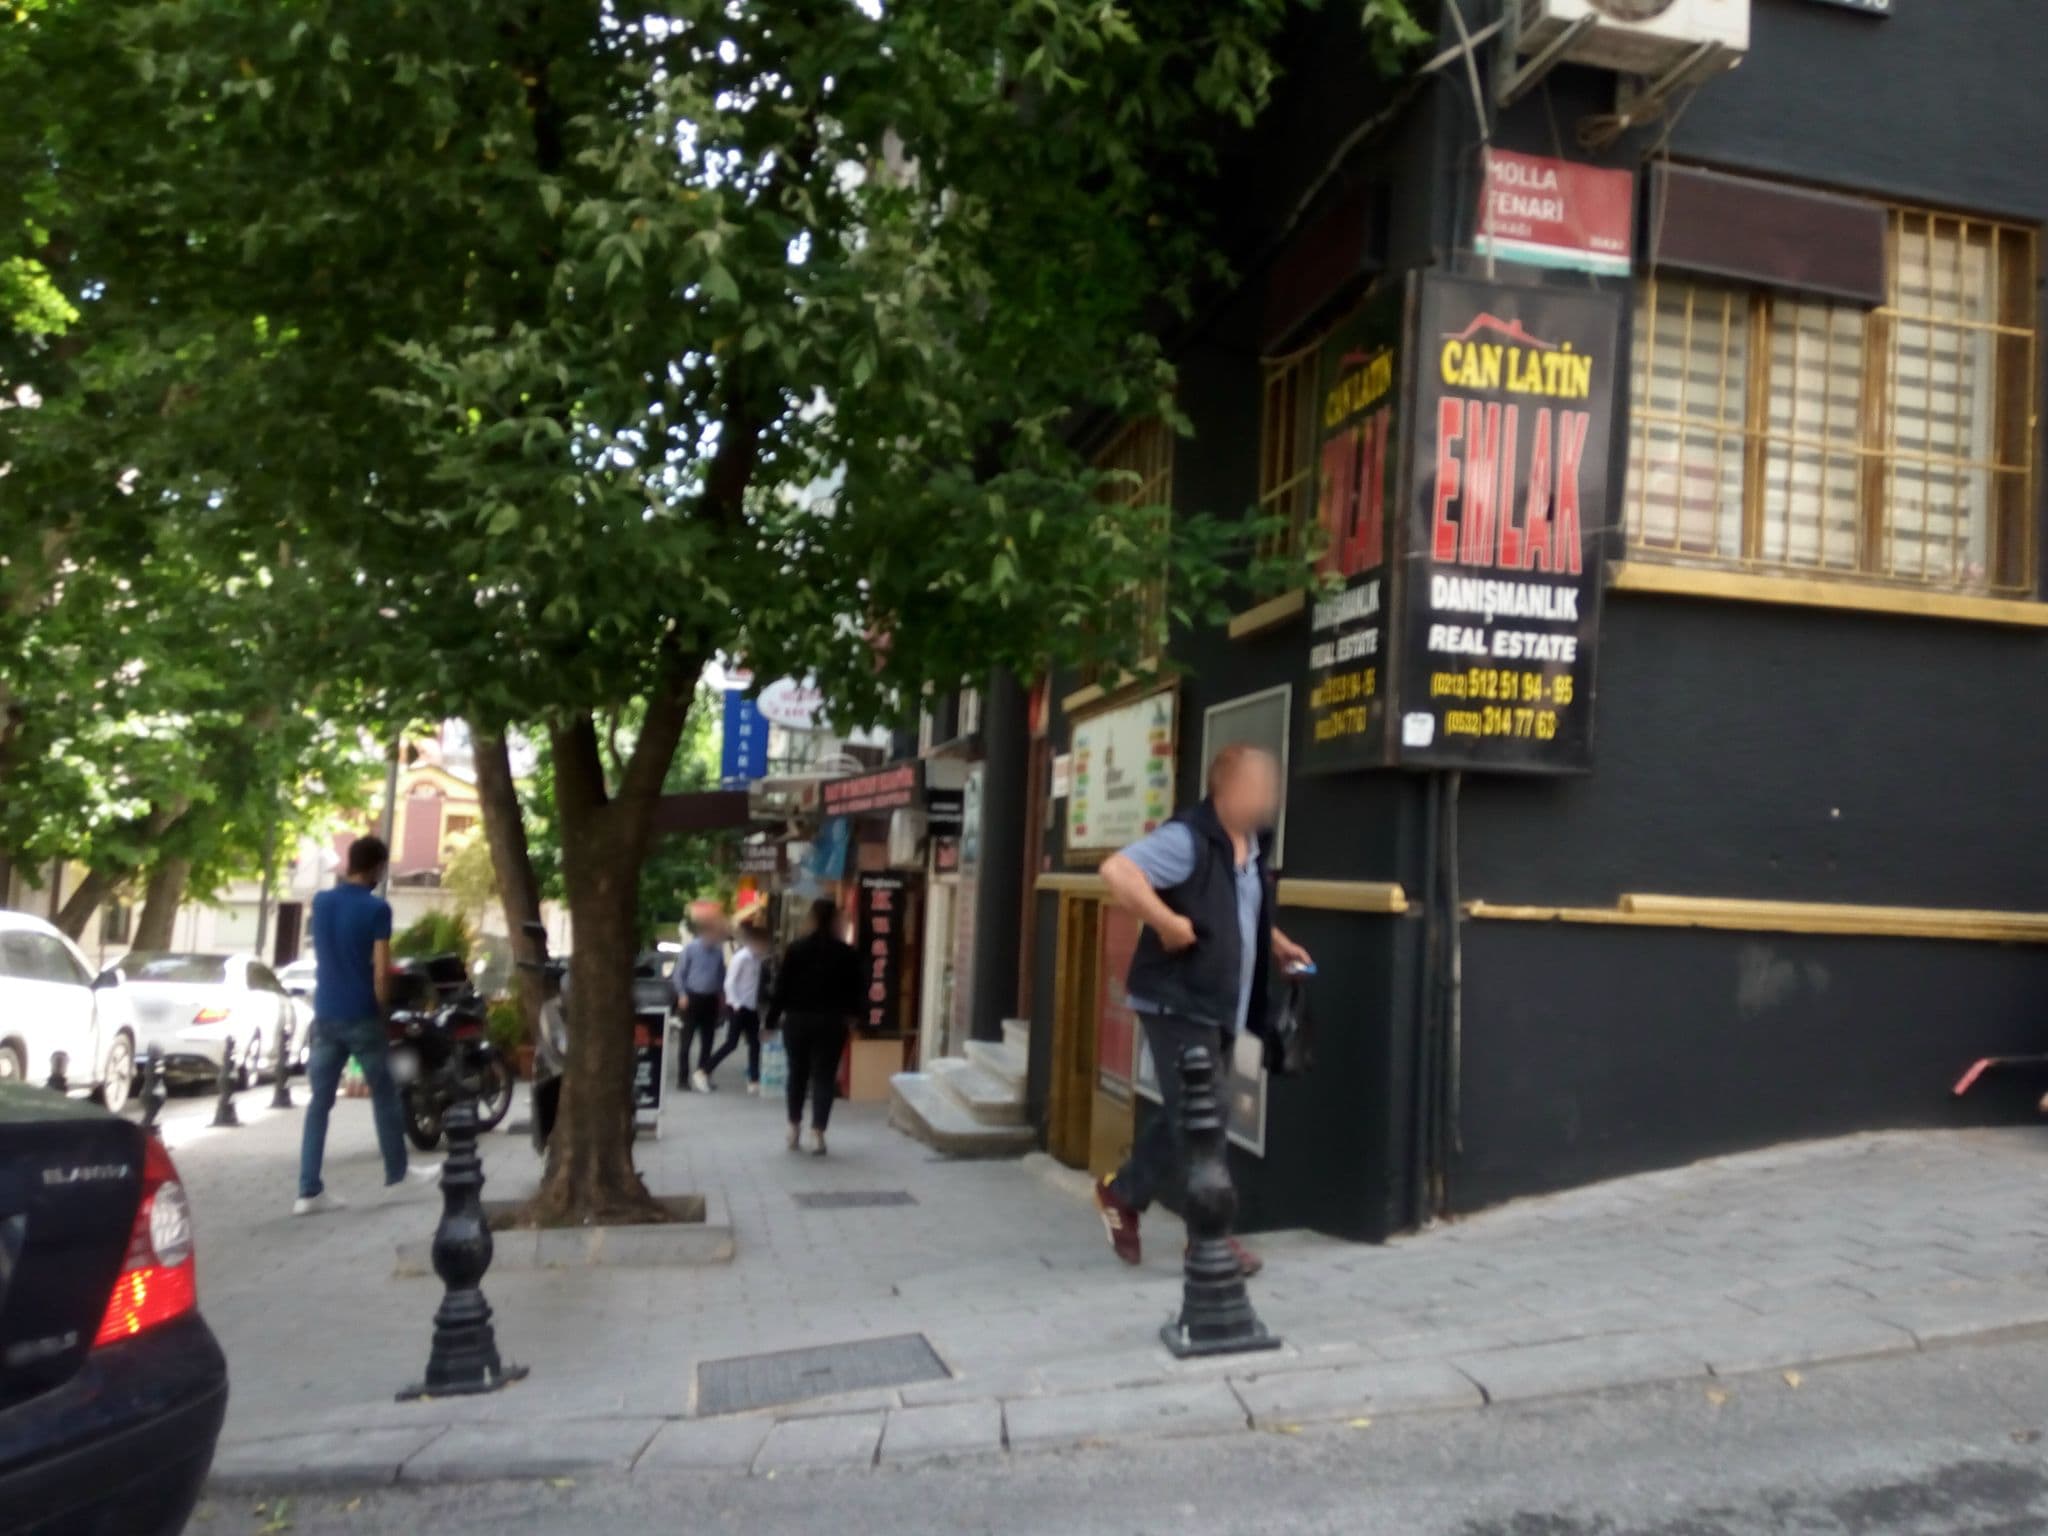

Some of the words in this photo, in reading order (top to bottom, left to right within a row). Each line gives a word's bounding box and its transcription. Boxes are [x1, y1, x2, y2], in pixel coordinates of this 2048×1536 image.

[1440, 340, 1504, 389] CAN
[1506, 341, 1593, 398] LATİN
[1433, 396, 1590, 576] EMLAK
[1431, 575, 1580, 624] DANIŞMANLIK
[1428, 623, 1488, 656] REAL
[1492, 630, 1578, 663] ESTATE
[1467, 667, 1498, 699] 512
[1500, 669, 1519, 699] 51
